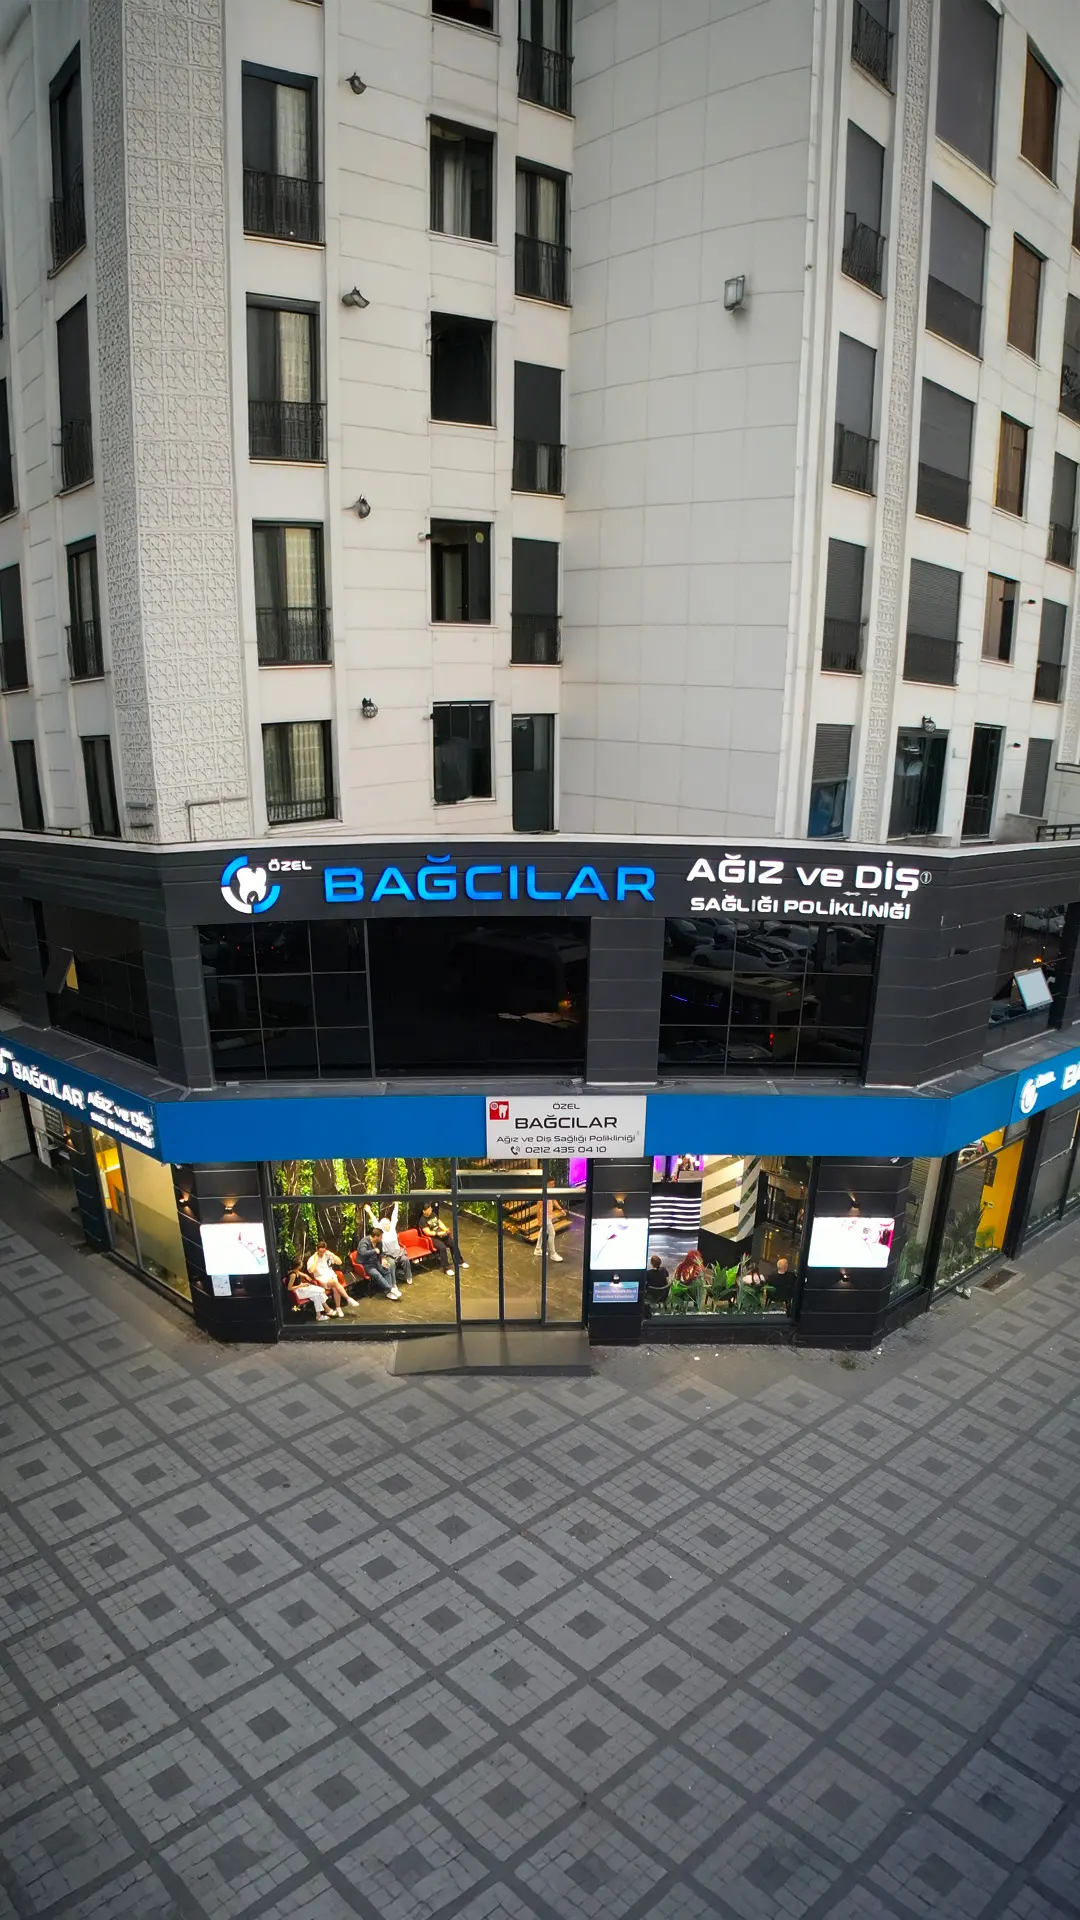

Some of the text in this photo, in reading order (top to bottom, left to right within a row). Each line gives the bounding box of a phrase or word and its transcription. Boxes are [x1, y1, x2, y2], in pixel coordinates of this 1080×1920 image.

[268, 858, 312, 872] ÖZEL
[324, 854, 656, 902] BAĞCILAR
[687, 853, 785, 884] AĞIZ
[796, 867, 844, 888] ve
[855, 860, 920, 899] DİŞ
[690, 895, 911, 919] SAĞLIĞI POLİKLİNİĞİ
[11, 1063, 86, 1110] BAĞCILAR
[553, 1102, 580, 1110] ÖZEL
[515, 1115, 617, 1129] BAĞCILAR
[496, 1135, 519, 1144] Ağız
[536, 1135, 552, 1144] Diş
[554, 1135, 587, 1144] Sağlığı
[590, 1135, 635, 1143] Polikliniği
[525, 1146, 551, 1154] 0212
[553, 1146, 575, 1154] 435
[577, 1146, 594, 1154] 04
